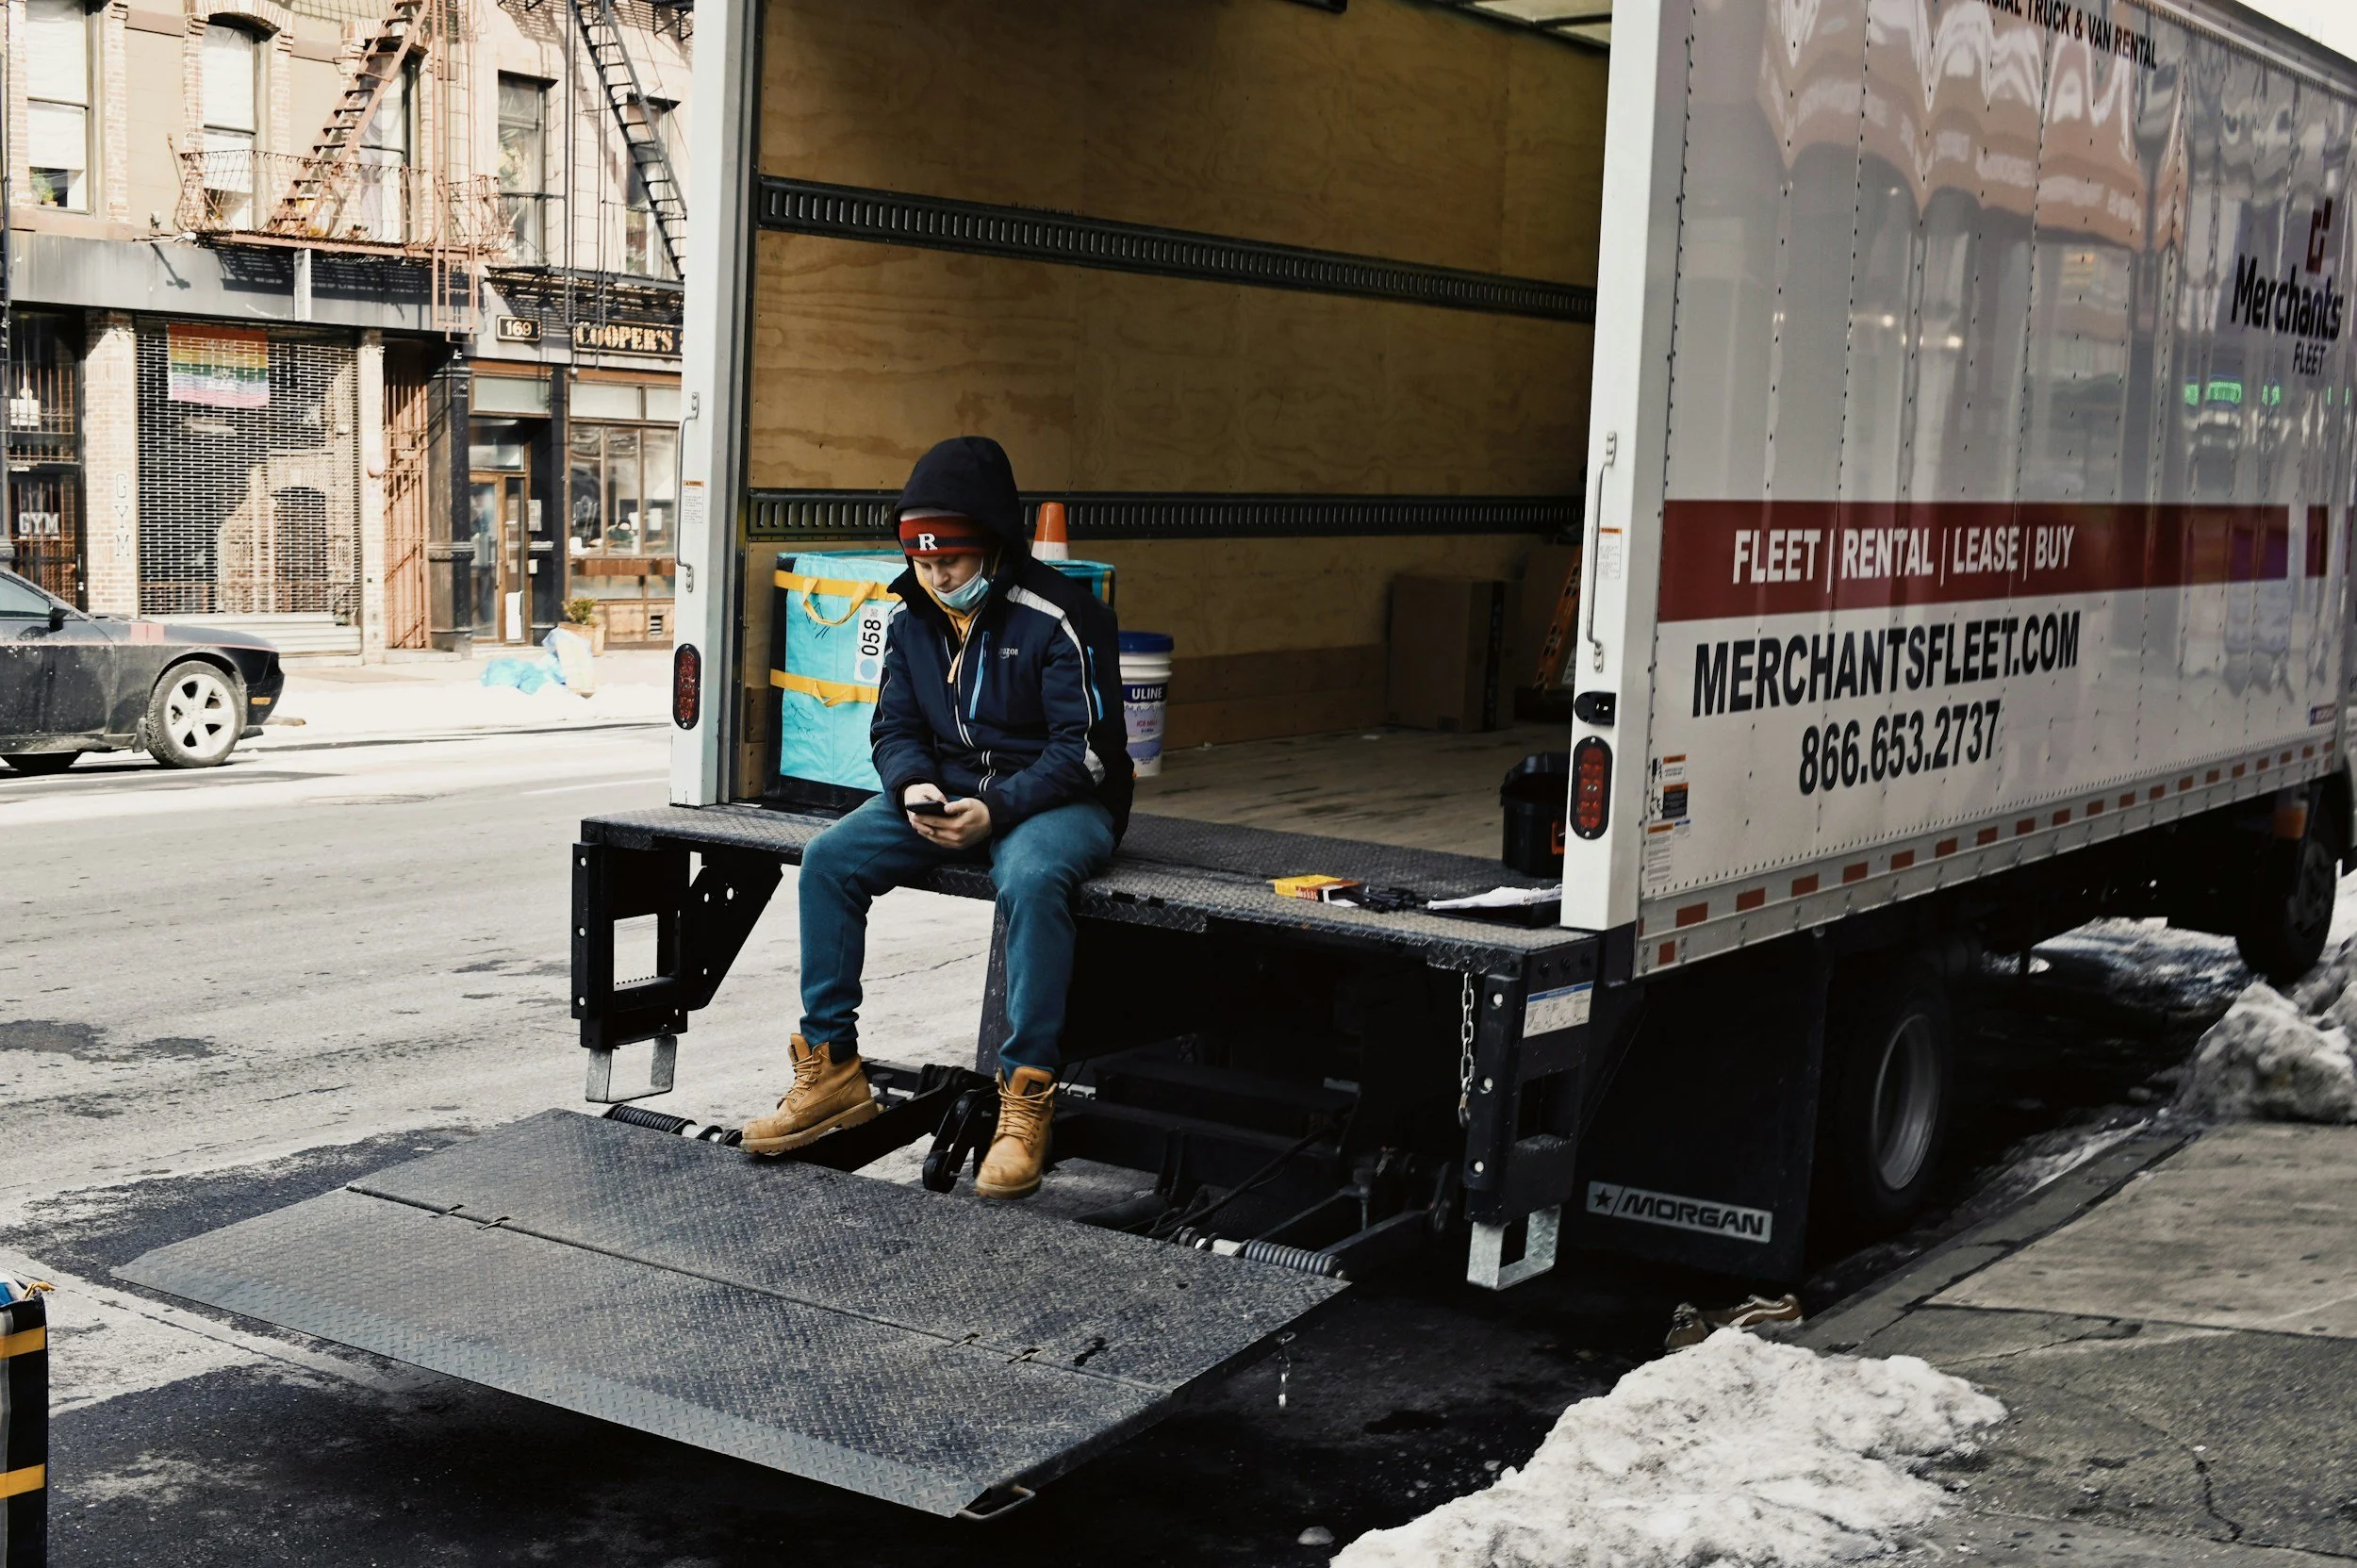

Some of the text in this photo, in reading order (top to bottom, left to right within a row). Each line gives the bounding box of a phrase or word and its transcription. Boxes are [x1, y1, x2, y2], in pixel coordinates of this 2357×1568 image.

[2027, 0, 2071, 36] TRUCK
[2074, 8, 2084, 41] &
[2087, 12, 2111, 54] VAN
[2114, 25, 2157, 71] RENTAL
[2231, 252, 2345, 342] Merchants
[505, 319, 533, 337] 169
[2292, 339, 2327, 377] FLEET
[19, 511, 59, 535] GYM
[917, 533, 938, 552] R
[1732, 524, 2074, 585] FLEET RENTAL LEASE BUY
[861, 619, 882, 656] 058
[1691, 610, 2081, 718] MERCHANTSFLEET.COM
[1131, 687, 1162, 701] ULINE
[1798, 698, 2002, 796] 866.653.2737
[1621, 1193, 1765, 1237] MORGAN
